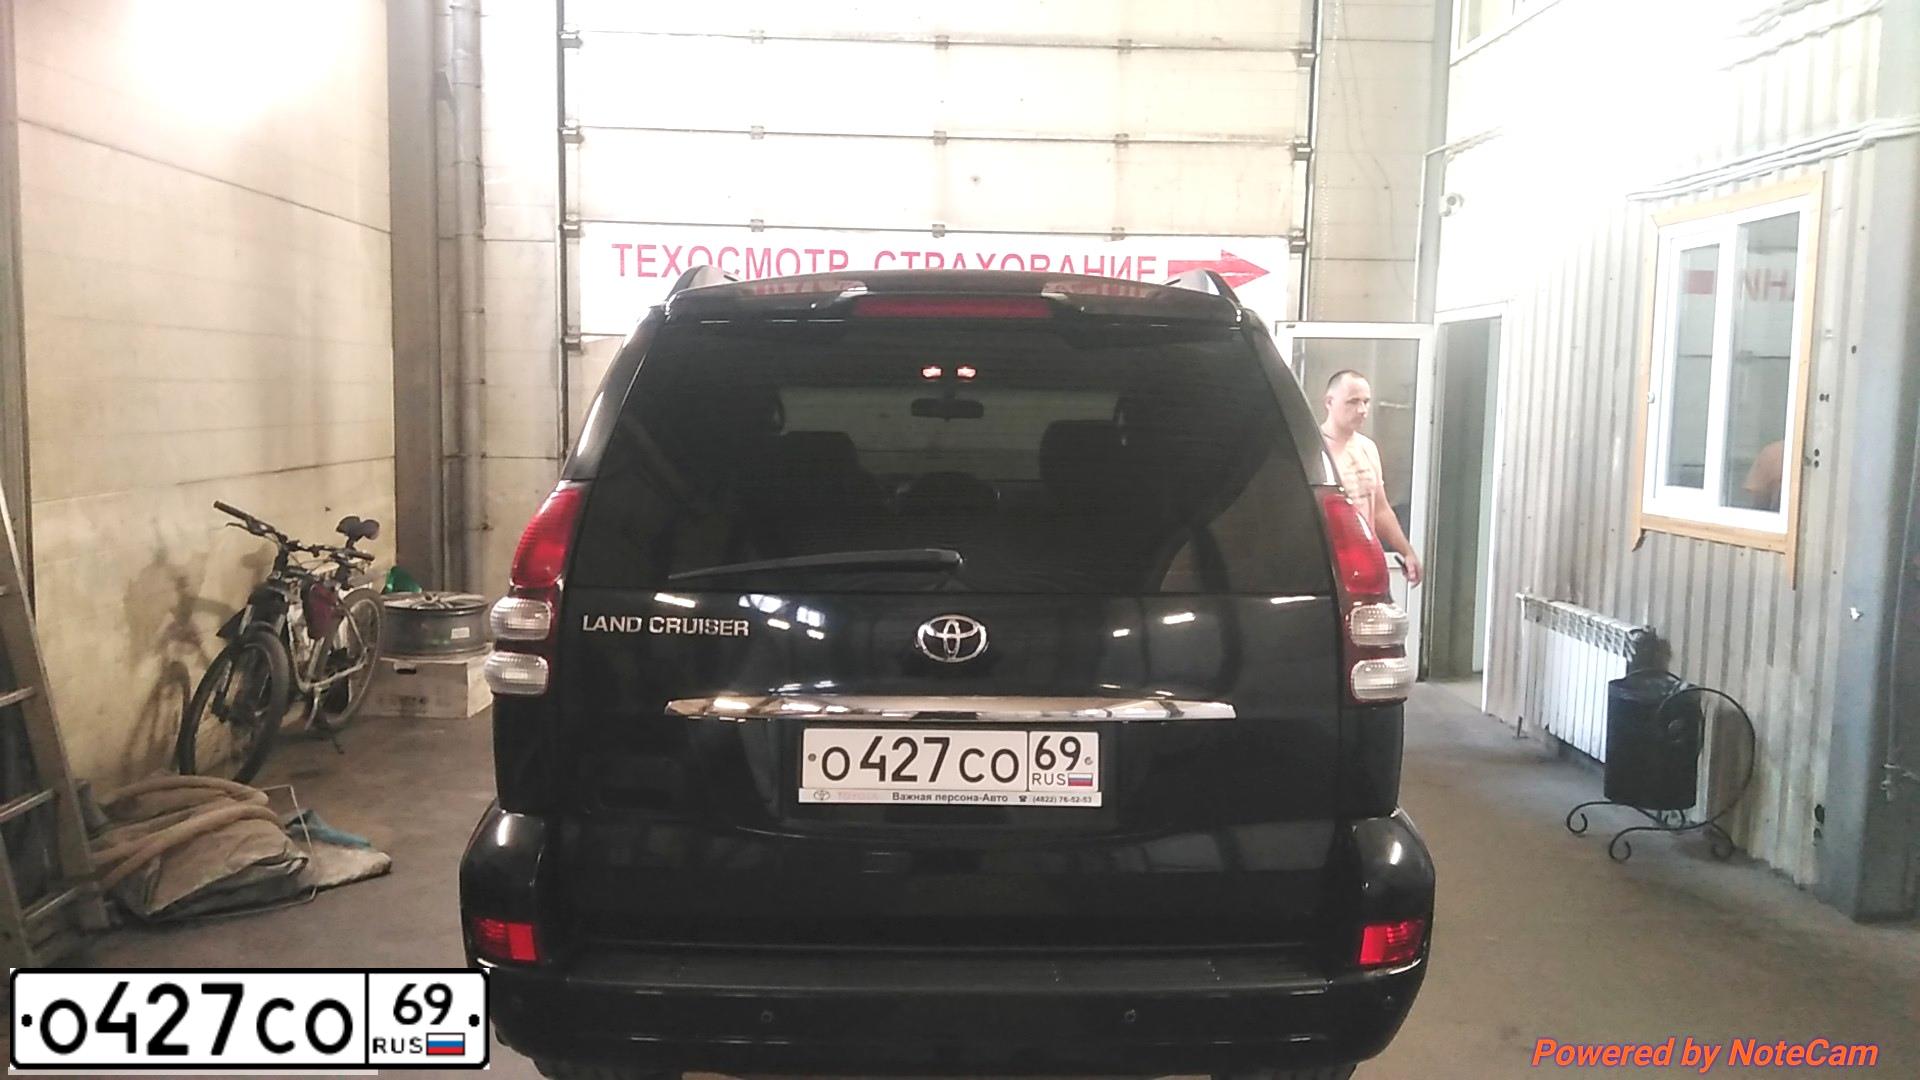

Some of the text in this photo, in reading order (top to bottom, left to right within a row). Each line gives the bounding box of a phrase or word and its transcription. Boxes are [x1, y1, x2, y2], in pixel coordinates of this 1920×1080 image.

[612, 243, 849, 279] ТЕХОСМОТР
[583, 615, 749, 636] LAND CRUISER
[1035, 735, 1082, 771] 69
[1032, 773, 1068, 786] RUS
[892, 792, 1009, 804] Важная персона-Авто
